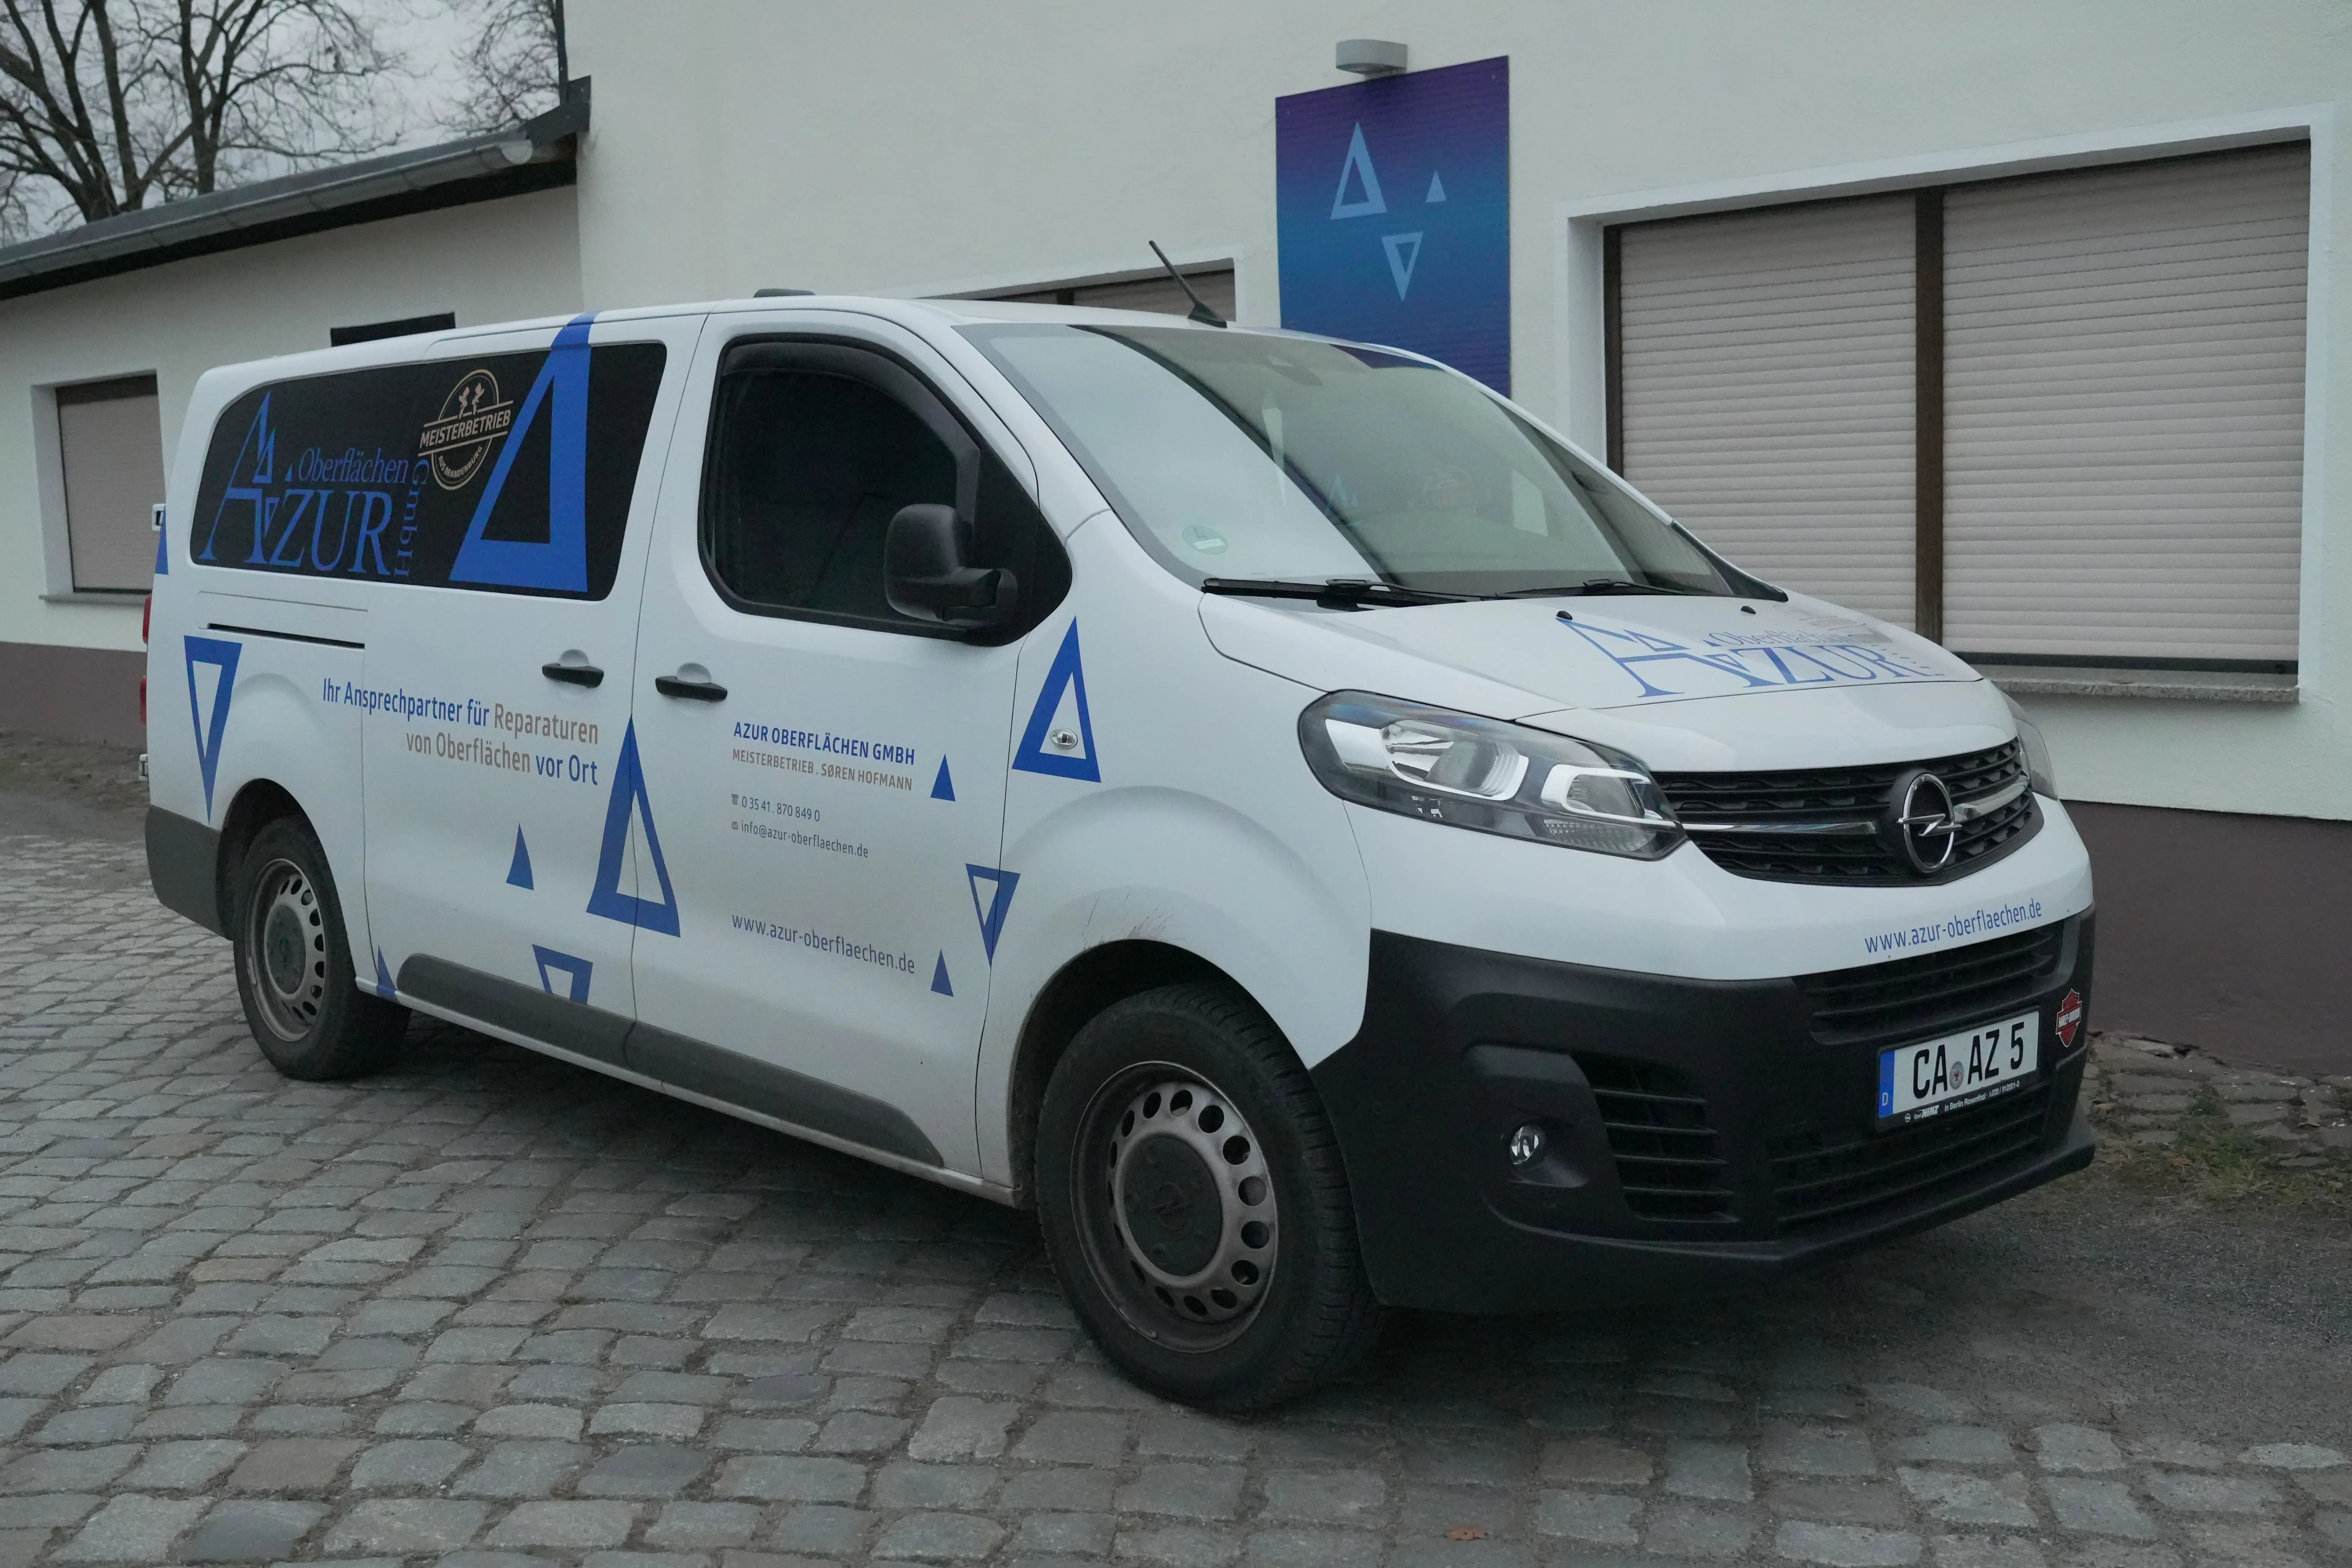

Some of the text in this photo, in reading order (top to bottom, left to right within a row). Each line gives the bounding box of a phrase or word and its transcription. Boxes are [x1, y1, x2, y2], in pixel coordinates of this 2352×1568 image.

[419, 409, 511, 449] MEISTERBETRIEB
[298, 447, 408, 484] Oberflächen
[444, 445, 483, 478] BRANDENBURG
[395, 458, 429, 577] GmbH
[322, 678, 599, 744] Ihr Ansprechpartner für Reparaturen
[406, 732, 597, 786] von Oberflächen vor Ort
[733, 722, 915, 766] AZUR OBERFLÄCHEN GMBH
[733, 748, 814, 774] MEISTERBETRIEB
[821, 763, 855, 781] SØREN
[858, 769, 912, 791] HOFMANN
[741, 820, 869, 858] info@azur-oberflaechen.de
[732, 915, 915, 974] www.azur-oberflaechen.de
[1865, 898, 2042, 953] www.azur-oberflaechen.de
[1913, 1021, 2025, 1099] CA AZ 5
[1882, 1092, 1888, 1106] D
[1949, 1100, 1964, 1110] Berlin
[1964, 1092, 1986, 1106] Rosenthal
